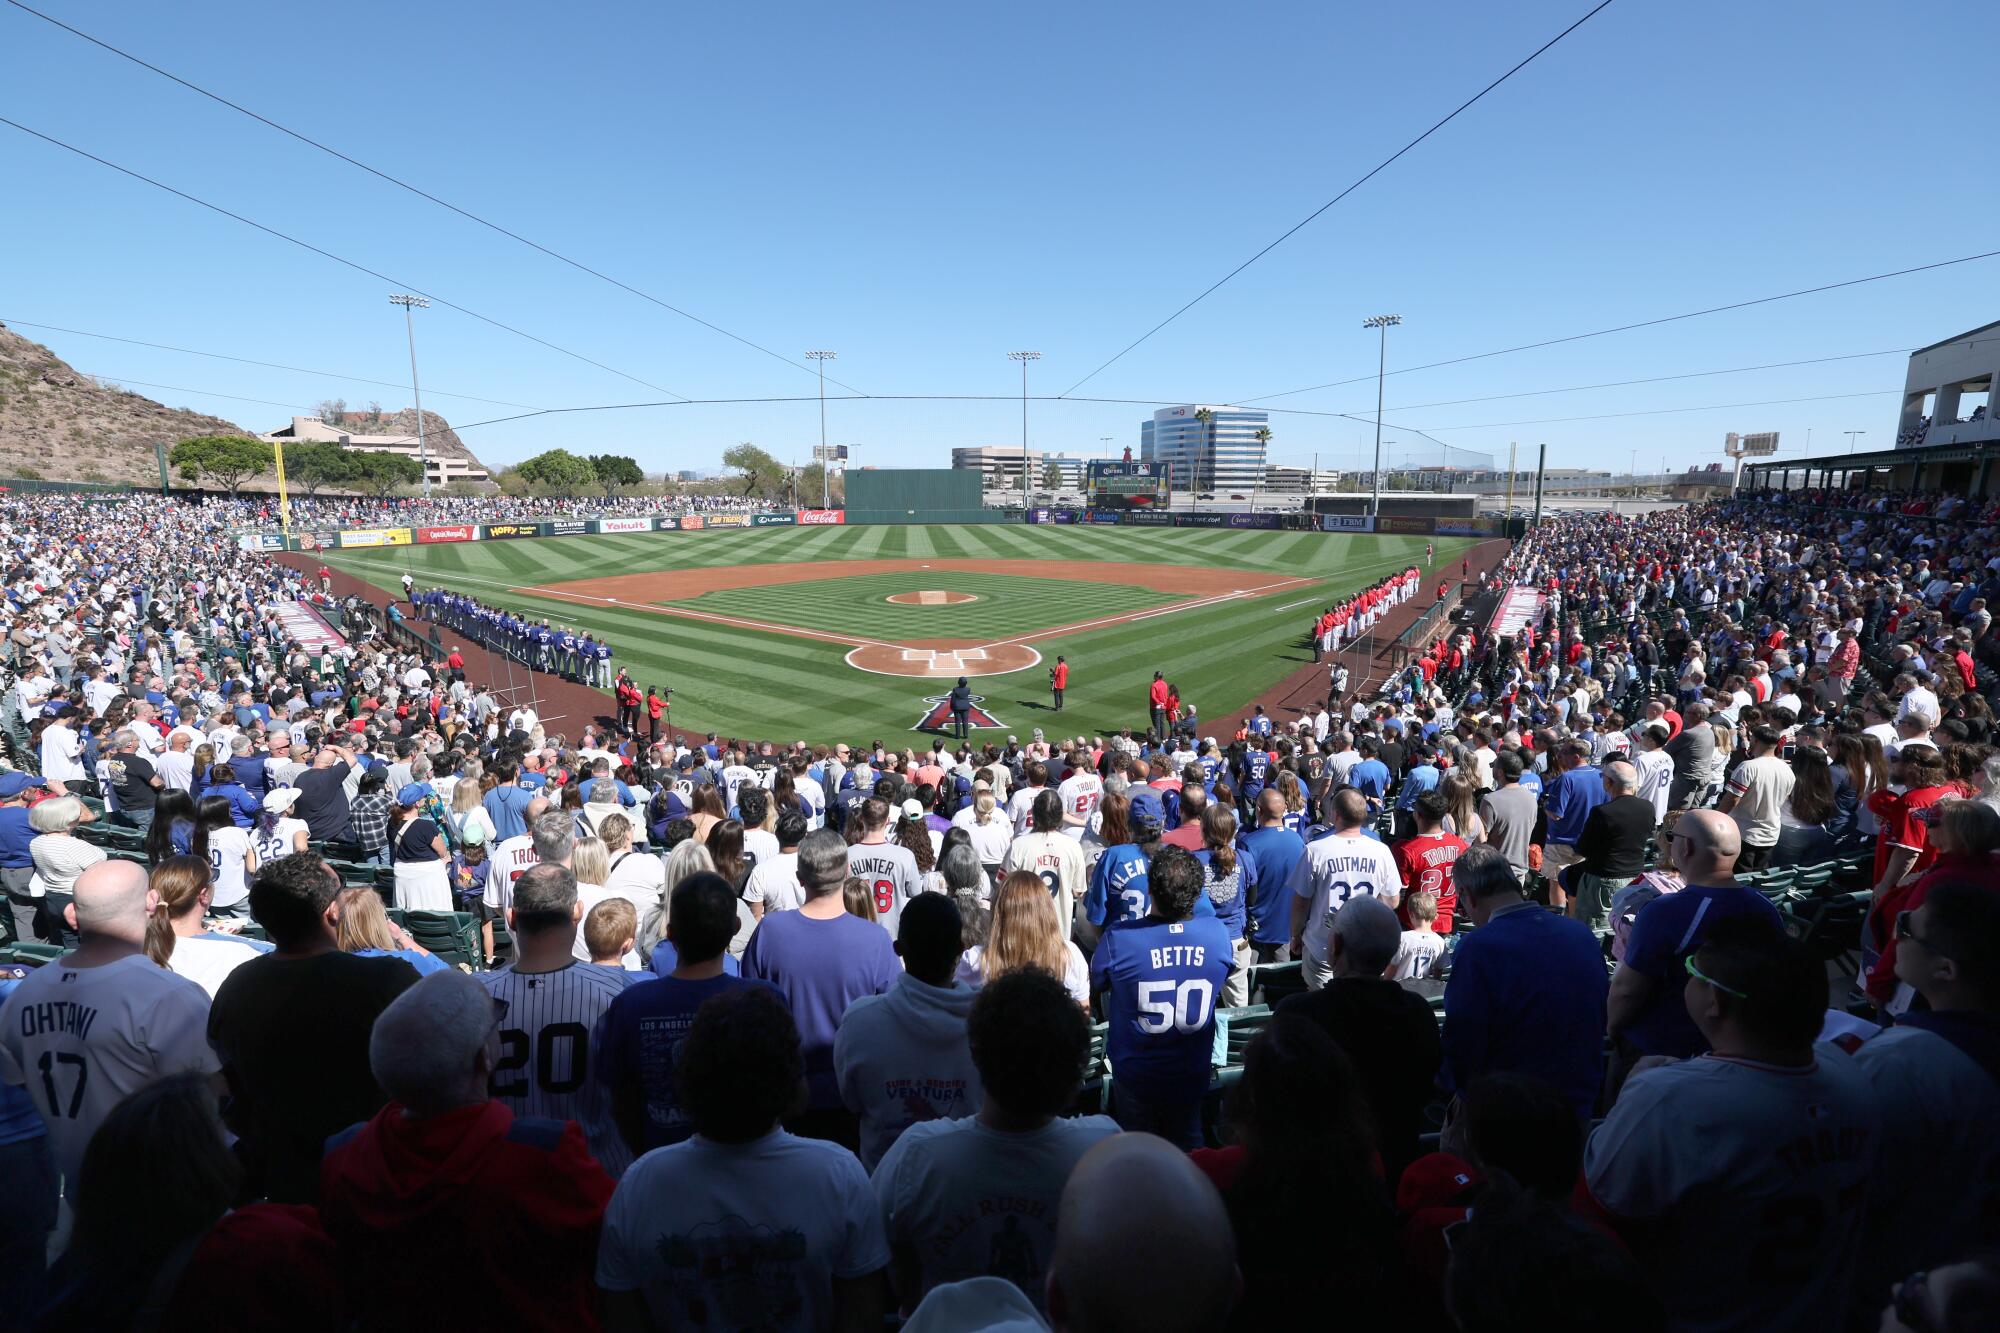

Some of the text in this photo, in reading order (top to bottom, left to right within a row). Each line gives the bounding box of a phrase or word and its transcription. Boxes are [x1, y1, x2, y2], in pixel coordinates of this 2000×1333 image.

[606, 522, 646, 530] Yakult
[803, 511, 837, 523] Coca-Cola
[490, 526, 517, 537] HOFFY
[1252, 765, 1265, 779] 50
[1657, 768, 1670, 788] 18
[1077, 780, 1096, 793] TROUT
[1076, 792, 1099, 813] 27
[259, 838, 294, 861] 22
[1422, 845, 1459, 868] TROUT
[850, 857, 895, 876] HUNTER
[1037, 854, 1060, 868] NETO
[1327, 856, 1377, 874] OUTMAN
[1151, 945, 1205, 969] BETTS
[1137, 978, 1214, 1035] 50
[21, 1001, 98, 1041] OHTANI
[640, 1022, 655, 1031] LOS
[487, 1021, 588, 1098] 20
[37, 1050, 88, 1120] 17
[885, 1086, 965, 1101] VENTURA
